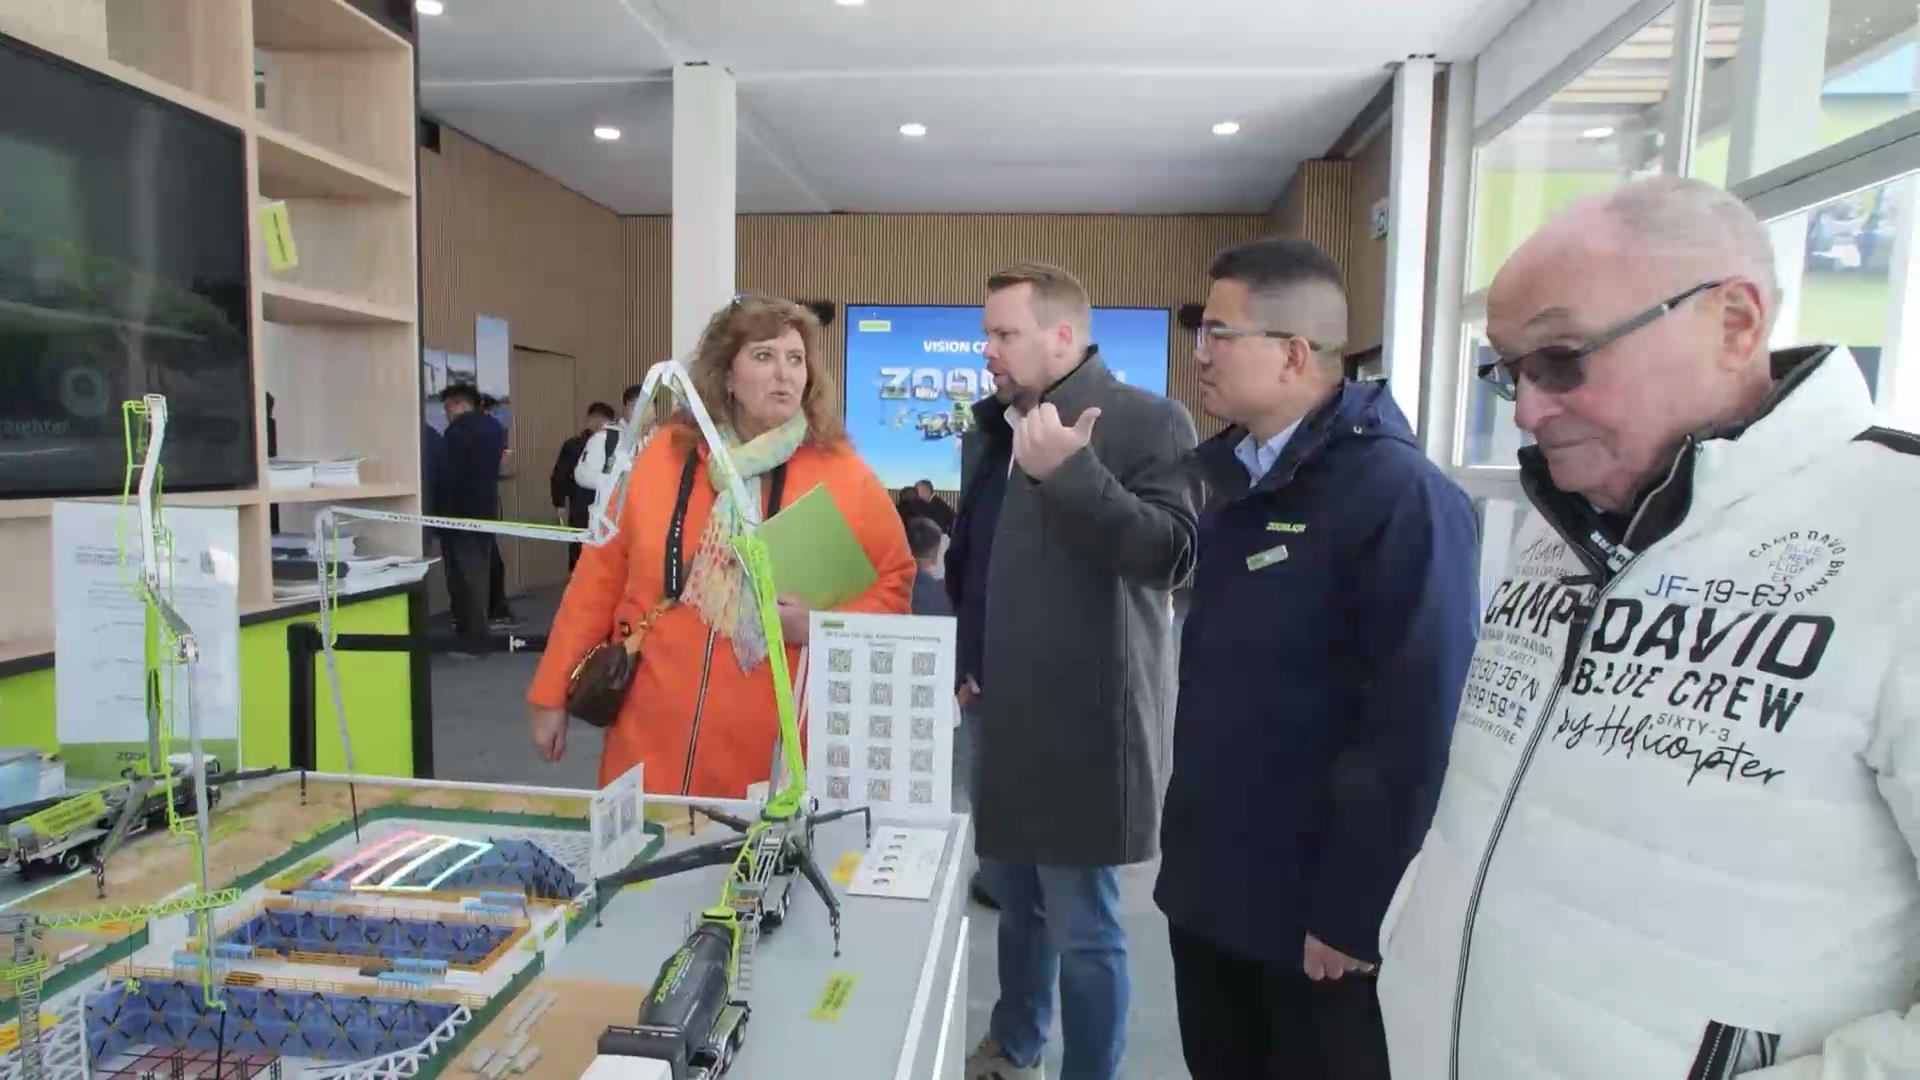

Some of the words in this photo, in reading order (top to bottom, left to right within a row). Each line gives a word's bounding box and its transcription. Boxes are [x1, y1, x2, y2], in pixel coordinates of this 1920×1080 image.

[923, 340, 970, 353] VISION
[1484, 580, 1582, 638] CAMP
[1591, 598, 1835, 680] DAVID
[1571, 658, 1664, 699] BLUE
[1667, 670, 1804, 733] CREW
[1656, 712, 1730, 742] SIXTY-3
[1552, 708, 1594, 750] by
[1595, 704, 1786, 786] Helicopter
